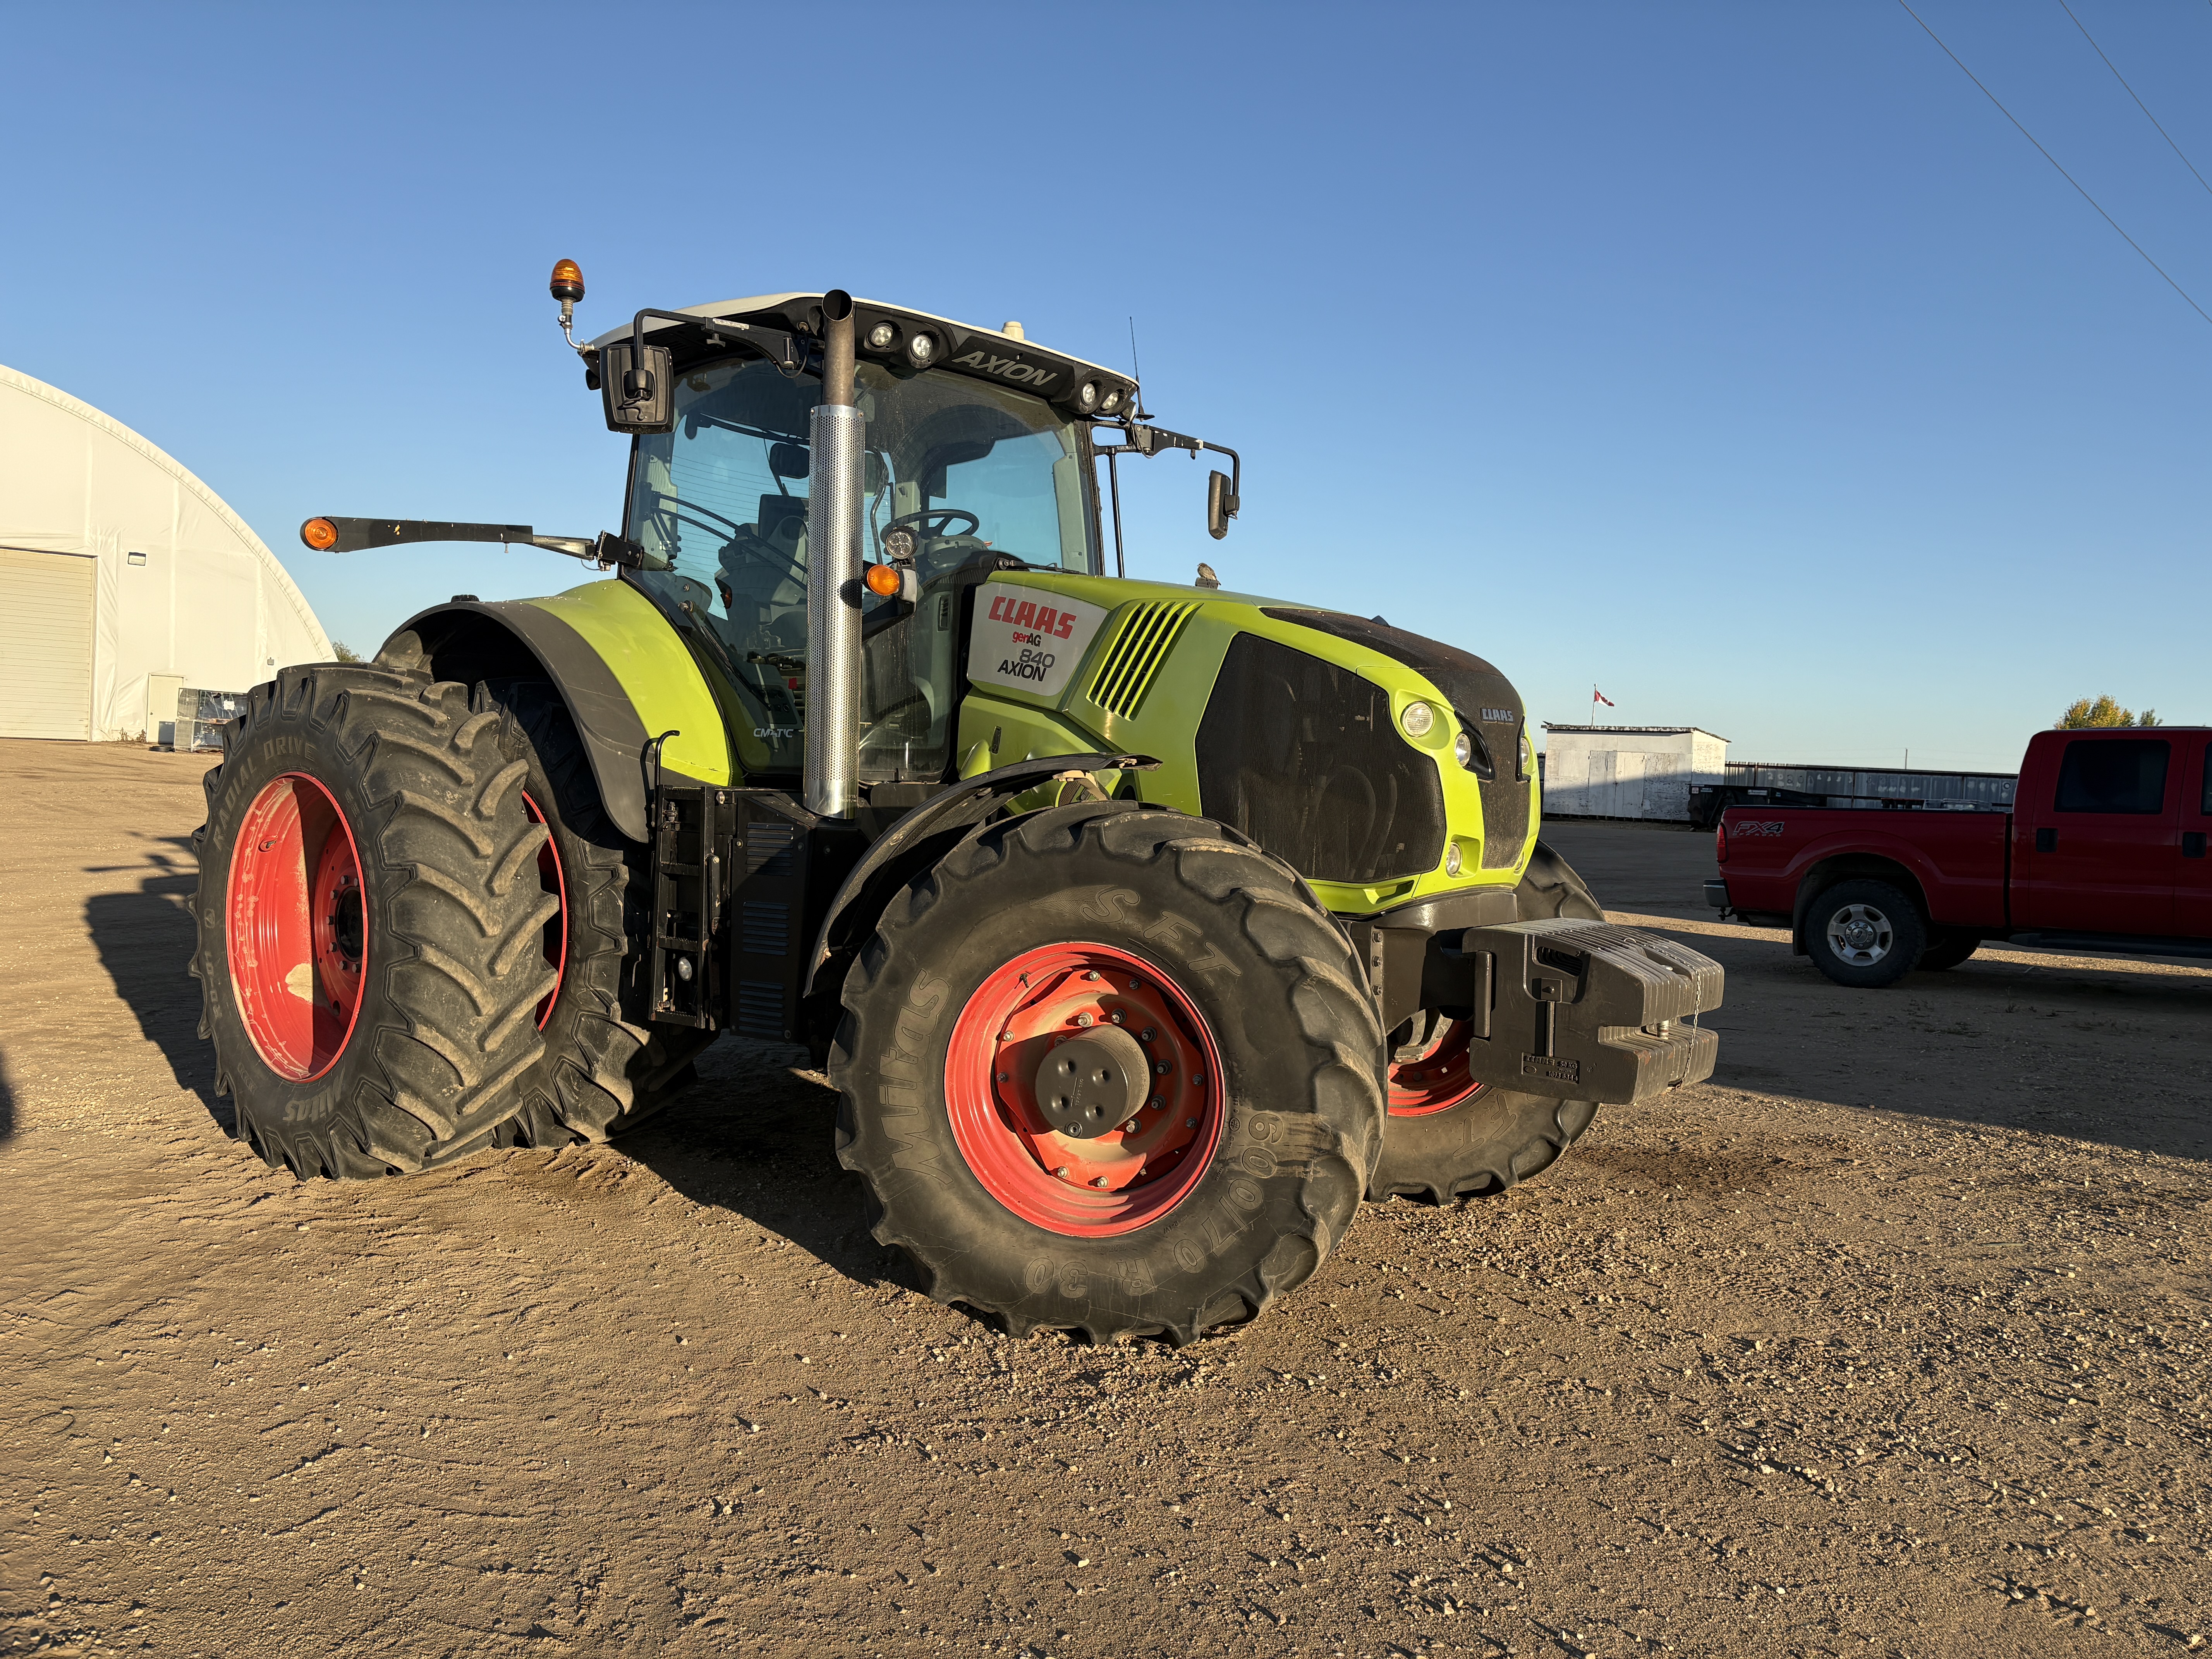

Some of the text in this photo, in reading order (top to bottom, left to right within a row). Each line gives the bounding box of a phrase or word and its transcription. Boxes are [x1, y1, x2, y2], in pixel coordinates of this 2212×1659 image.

[952, 351, 1057, 386] AXION
[988, 596, 1077, 639] CLAAS
[1012, 631, 1041, 647] genAG
[997, 659, 1046, 682] AXION
[1020, 649, 1055, 668] 840
[1481, 708, 1513, 722] CLAAS
[213, 736, 317, 851] RADIAL DRIVE
[1733, 821, 1785, 834] FX4
[879, 969, 953, 1185] Mitas
[1174, 1113, 1284, 1274] 600/70
[1025, 1257, 1088, 1298] 30
